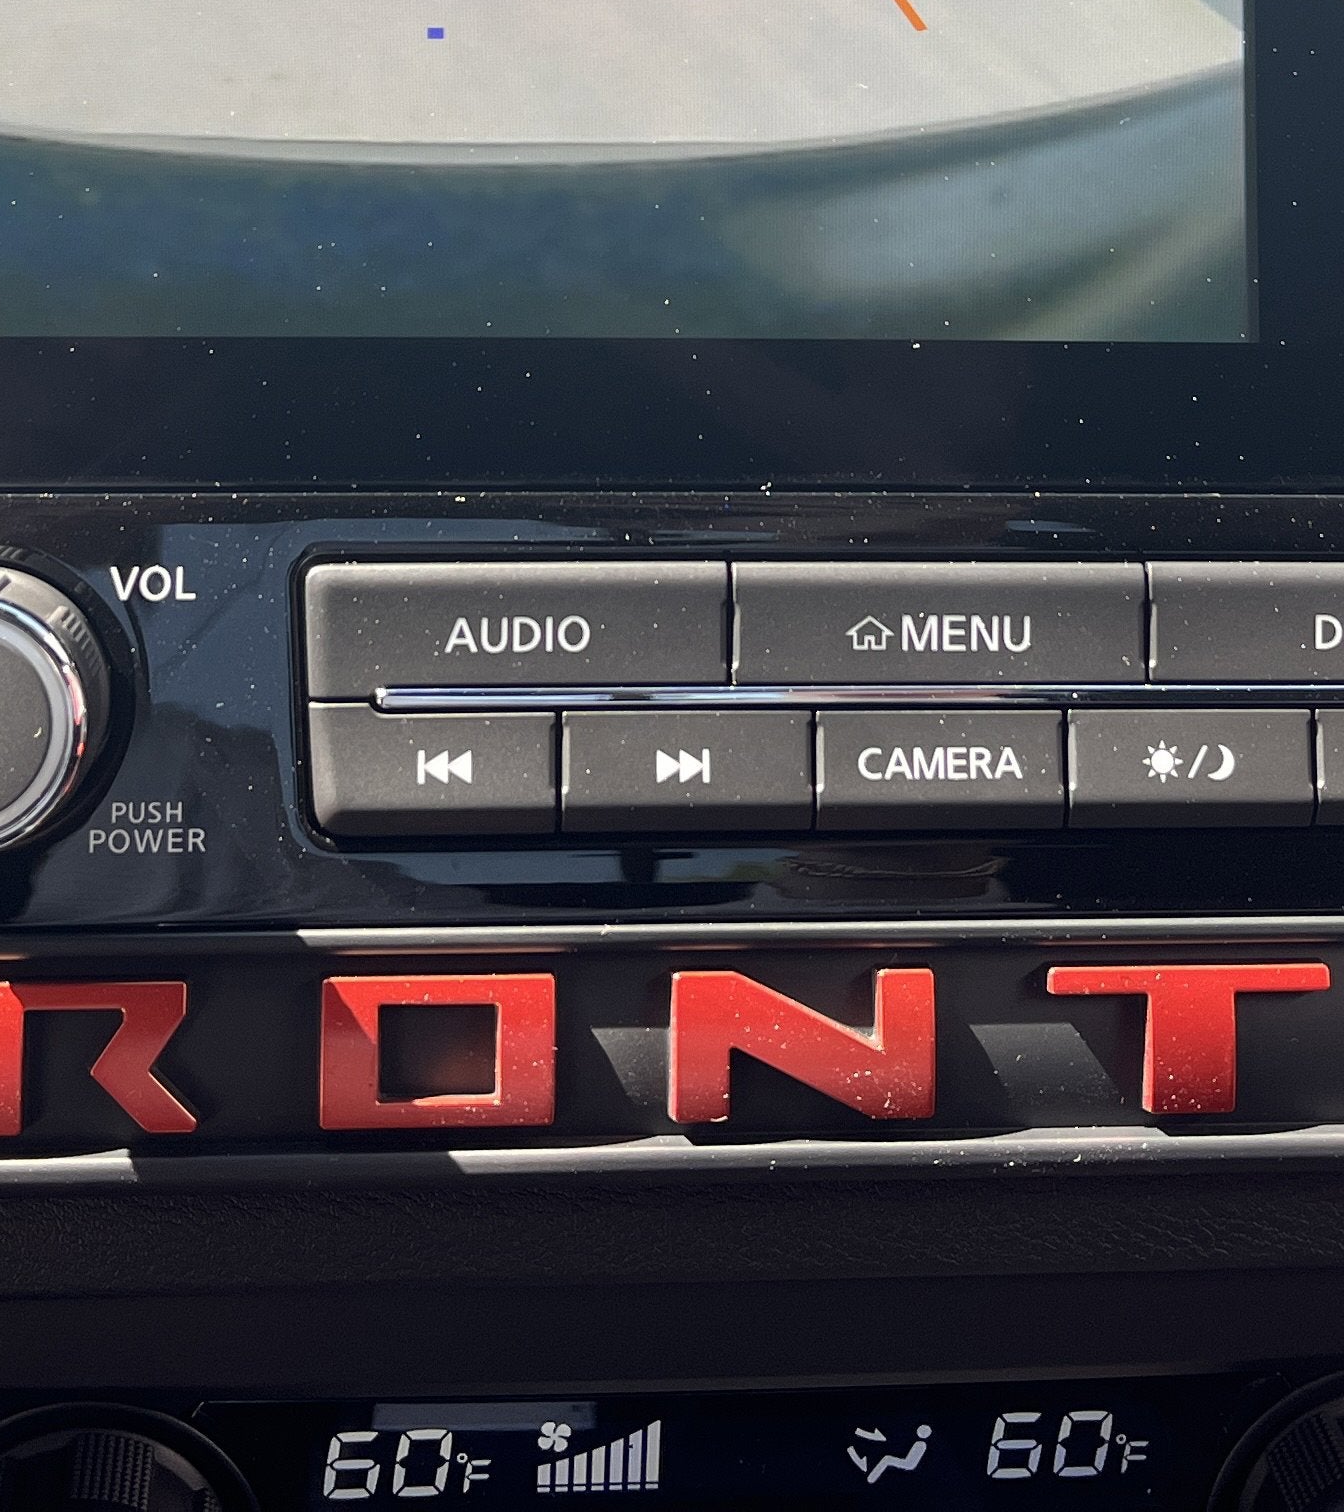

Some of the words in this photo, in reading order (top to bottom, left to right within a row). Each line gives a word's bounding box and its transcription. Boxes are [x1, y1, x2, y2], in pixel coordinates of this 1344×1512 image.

[109, 565, 197, 602] VOL
[444, 615, 591, 653] AUDIO
[901, 614, 1032, 653] MENU
[857, 745, 1024, 781] CAMERA
[111, 801, 183, 824] PUSH
[88, 828, 206, 854] POWER
